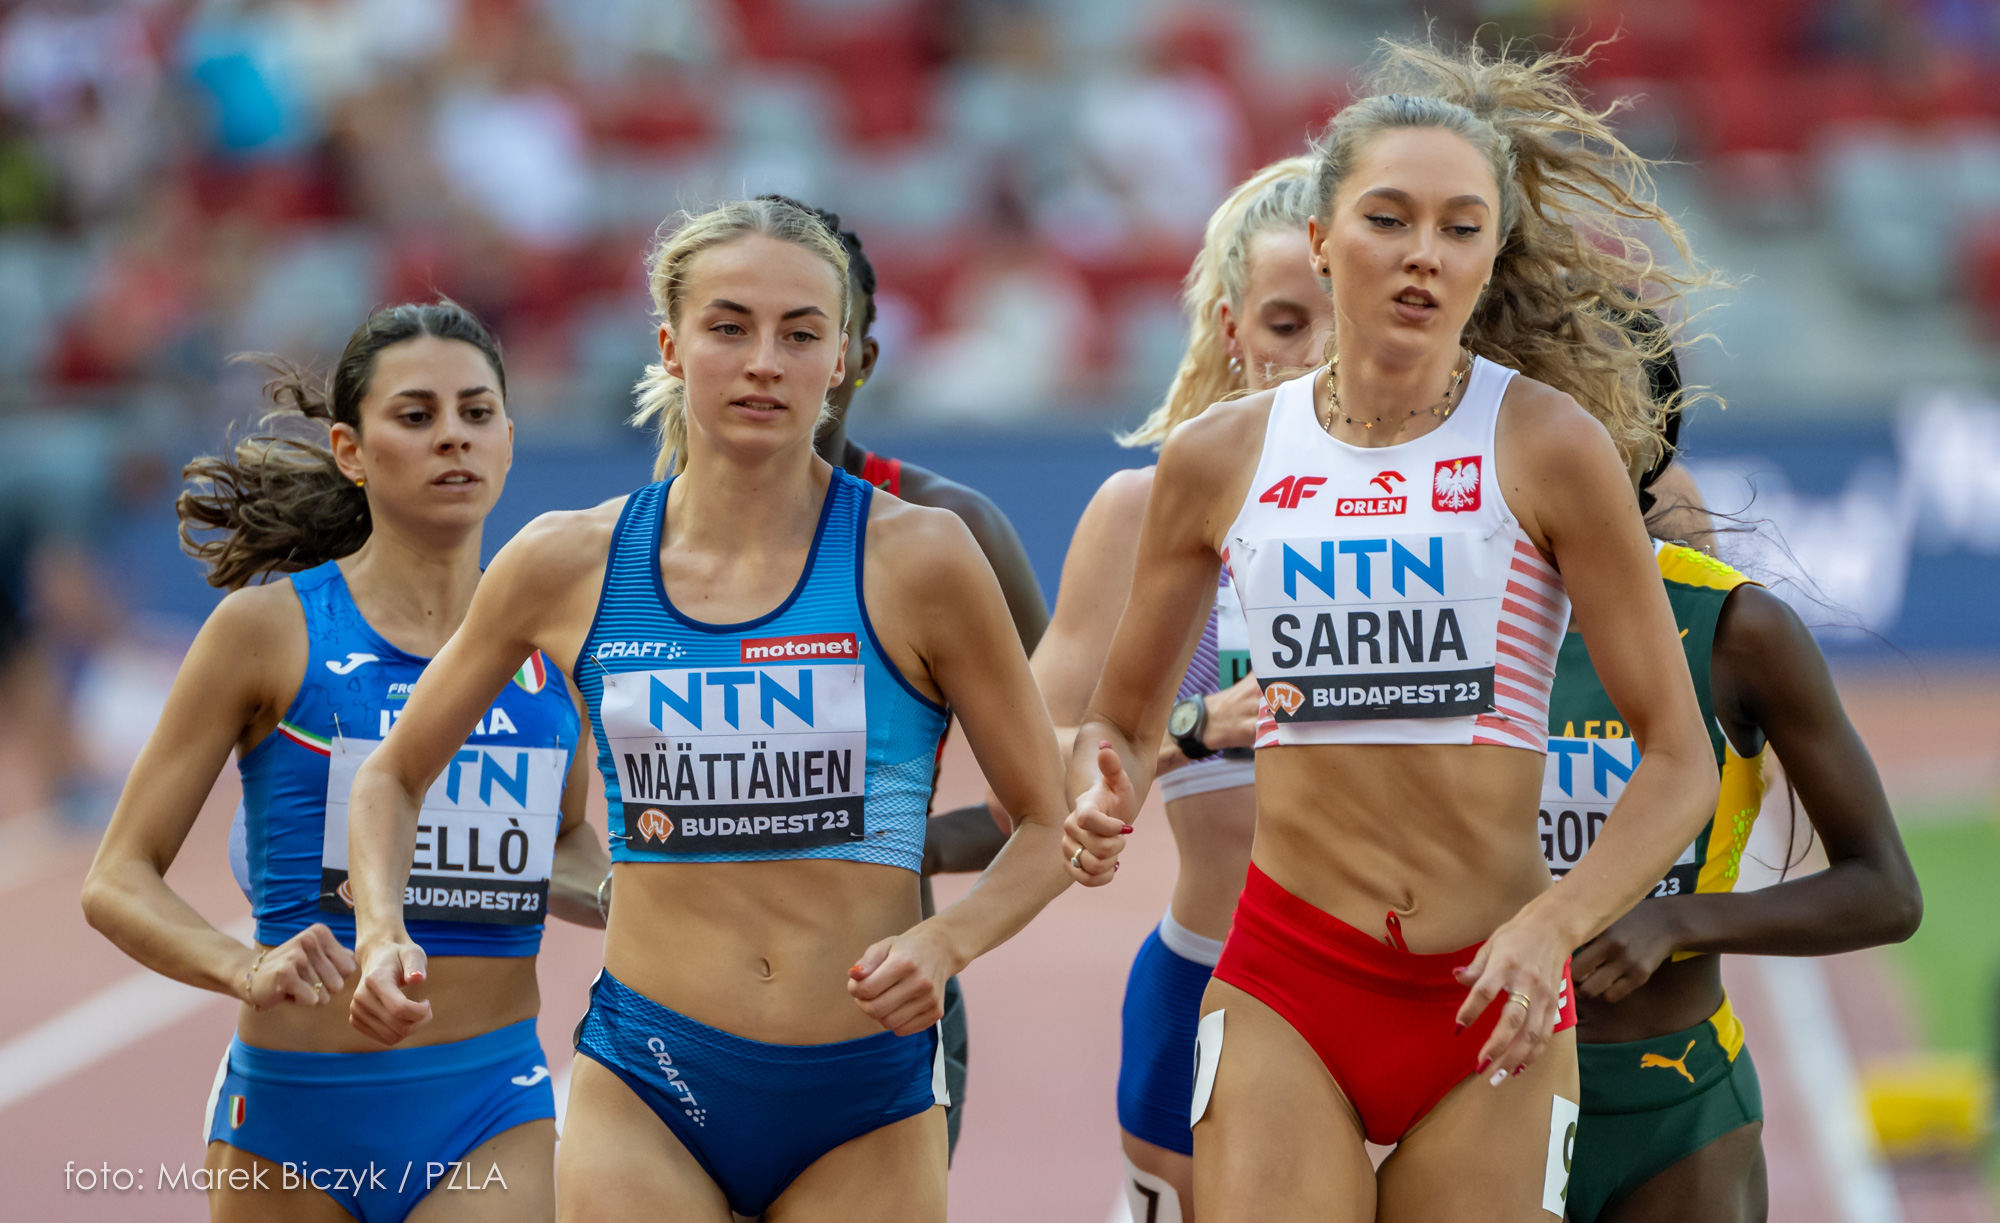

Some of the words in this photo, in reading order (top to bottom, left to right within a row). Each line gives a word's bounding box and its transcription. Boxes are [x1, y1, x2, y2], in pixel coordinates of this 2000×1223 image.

[1259, 475, 1328, 509] 4F
[1339, 499, 1403, 514] ORLEN
[1283, 536, 1445, 601] NTN
[597, 641, 666, 659] CRAFT
[746, 637, 853, 659] motonet
[1271, 607, 1468, 669] SARNA
[388, 683, 416, 694] FRE
[650, 669, 814, 732] NTN
[1313, 684, 1450, 708] BUDAPEST
[1454, 681, 1481, 701] 23
[446, 749, 529, 809] TN
[624, 741, 852, 800] MÄÄTTÄNEN
[1548, 739, 1642, 799] TN
[682, 813, 818, 837] BUDAPEST
[821, 810, 850, 830] 23
[411, 817, 529, 875] ELLÒ
[403, 887, 521, 911] BUDAPEST
[521, 892, 540, 912] 23
[1655, 877, 1680, 898] 23
[647, 1037, 698, 1106] CRAFT
